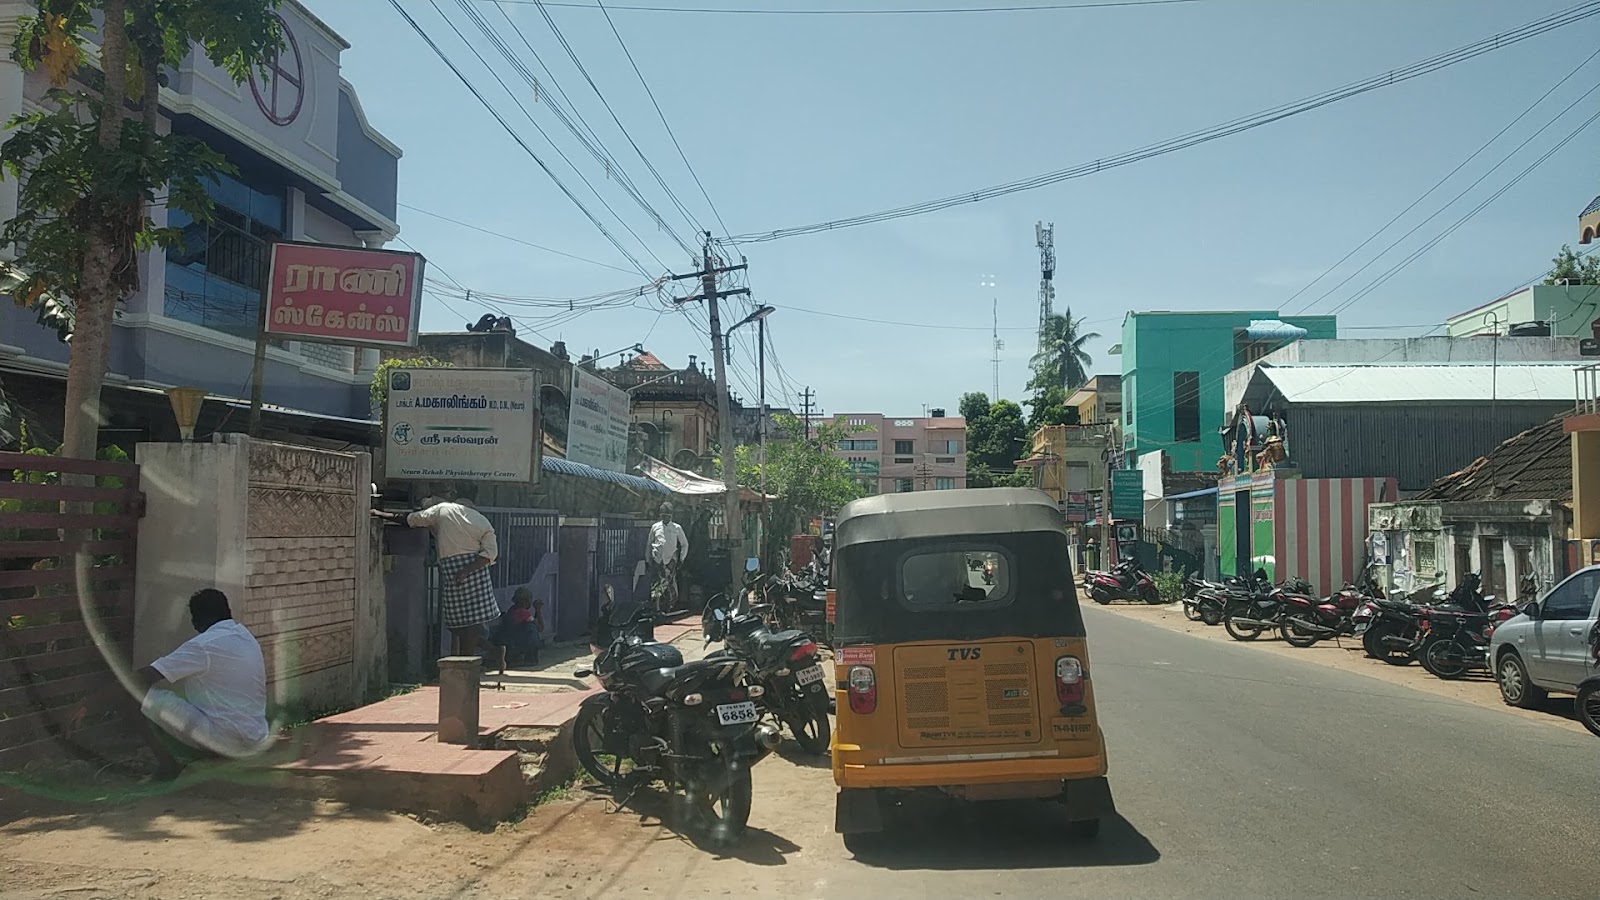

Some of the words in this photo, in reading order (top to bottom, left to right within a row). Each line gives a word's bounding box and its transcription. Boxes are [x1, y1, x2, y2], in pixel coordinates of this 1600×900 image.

[282, 263, 406, 297] ராணி
[274, 297, 405, 333] ஸ்கேன்ஸ்
[422, 468, 443, 476] Rehab
[445, 469, 492, 478] Physiotherapy
[947, 648, 981, 660] TVS
[722, 708, 755, 722] 6858
